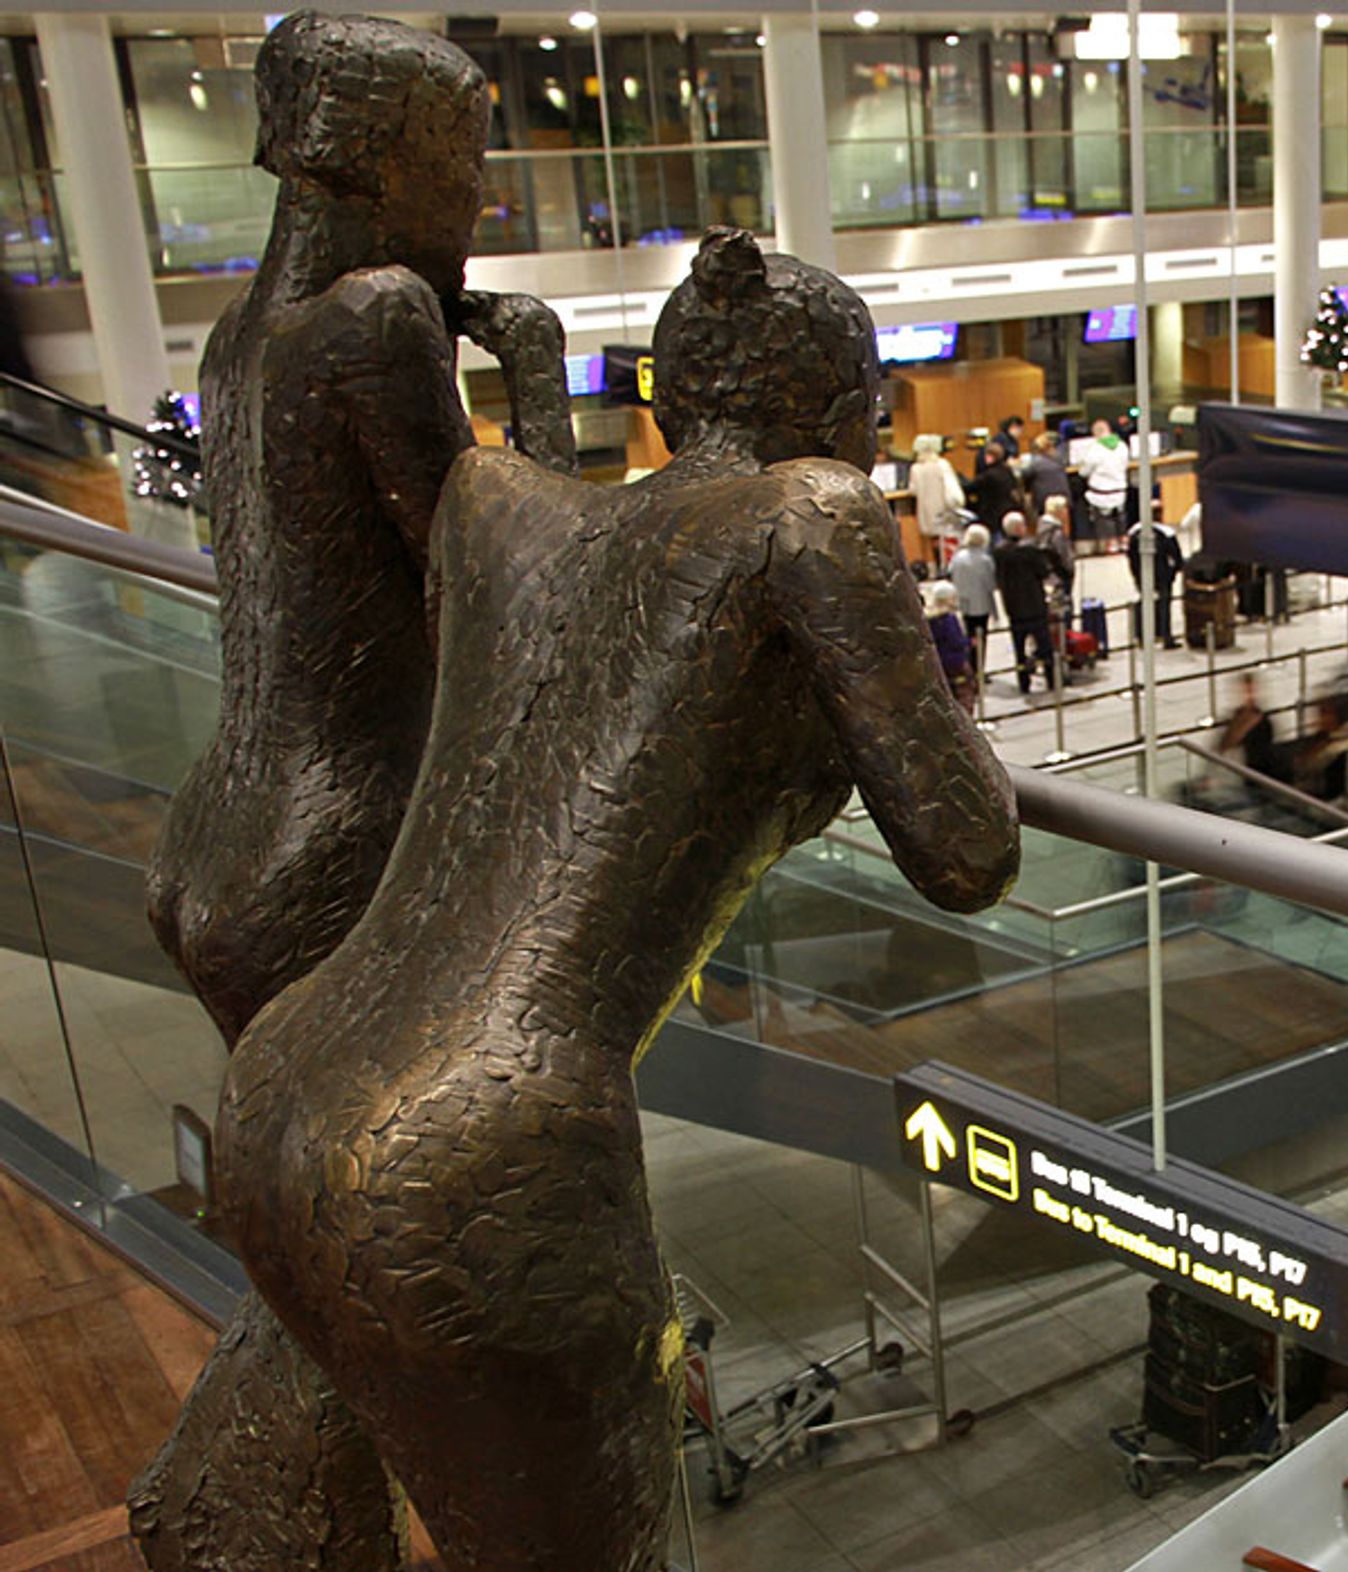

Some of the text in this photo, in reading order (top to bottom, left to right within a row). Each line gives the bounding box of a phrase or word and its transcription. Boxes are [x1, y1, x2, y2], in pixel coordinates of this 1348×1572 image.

[1030, 1150, 1068, 1186] Bus
[1092, 1176, 1174, 1231] Terminal
[1177, 1213, 1188, 1236] 1
[1190, 1223, 1220, 1255] og
[1033, 1188, 1070, 1223] Bus
[1072, 1206, 1094, 1232] to
[1094, 1214, 1176, 1270] Terminal
[1178, 1252, 1190, 1275] 1
[1192, 1262, 1234, 1295] and
